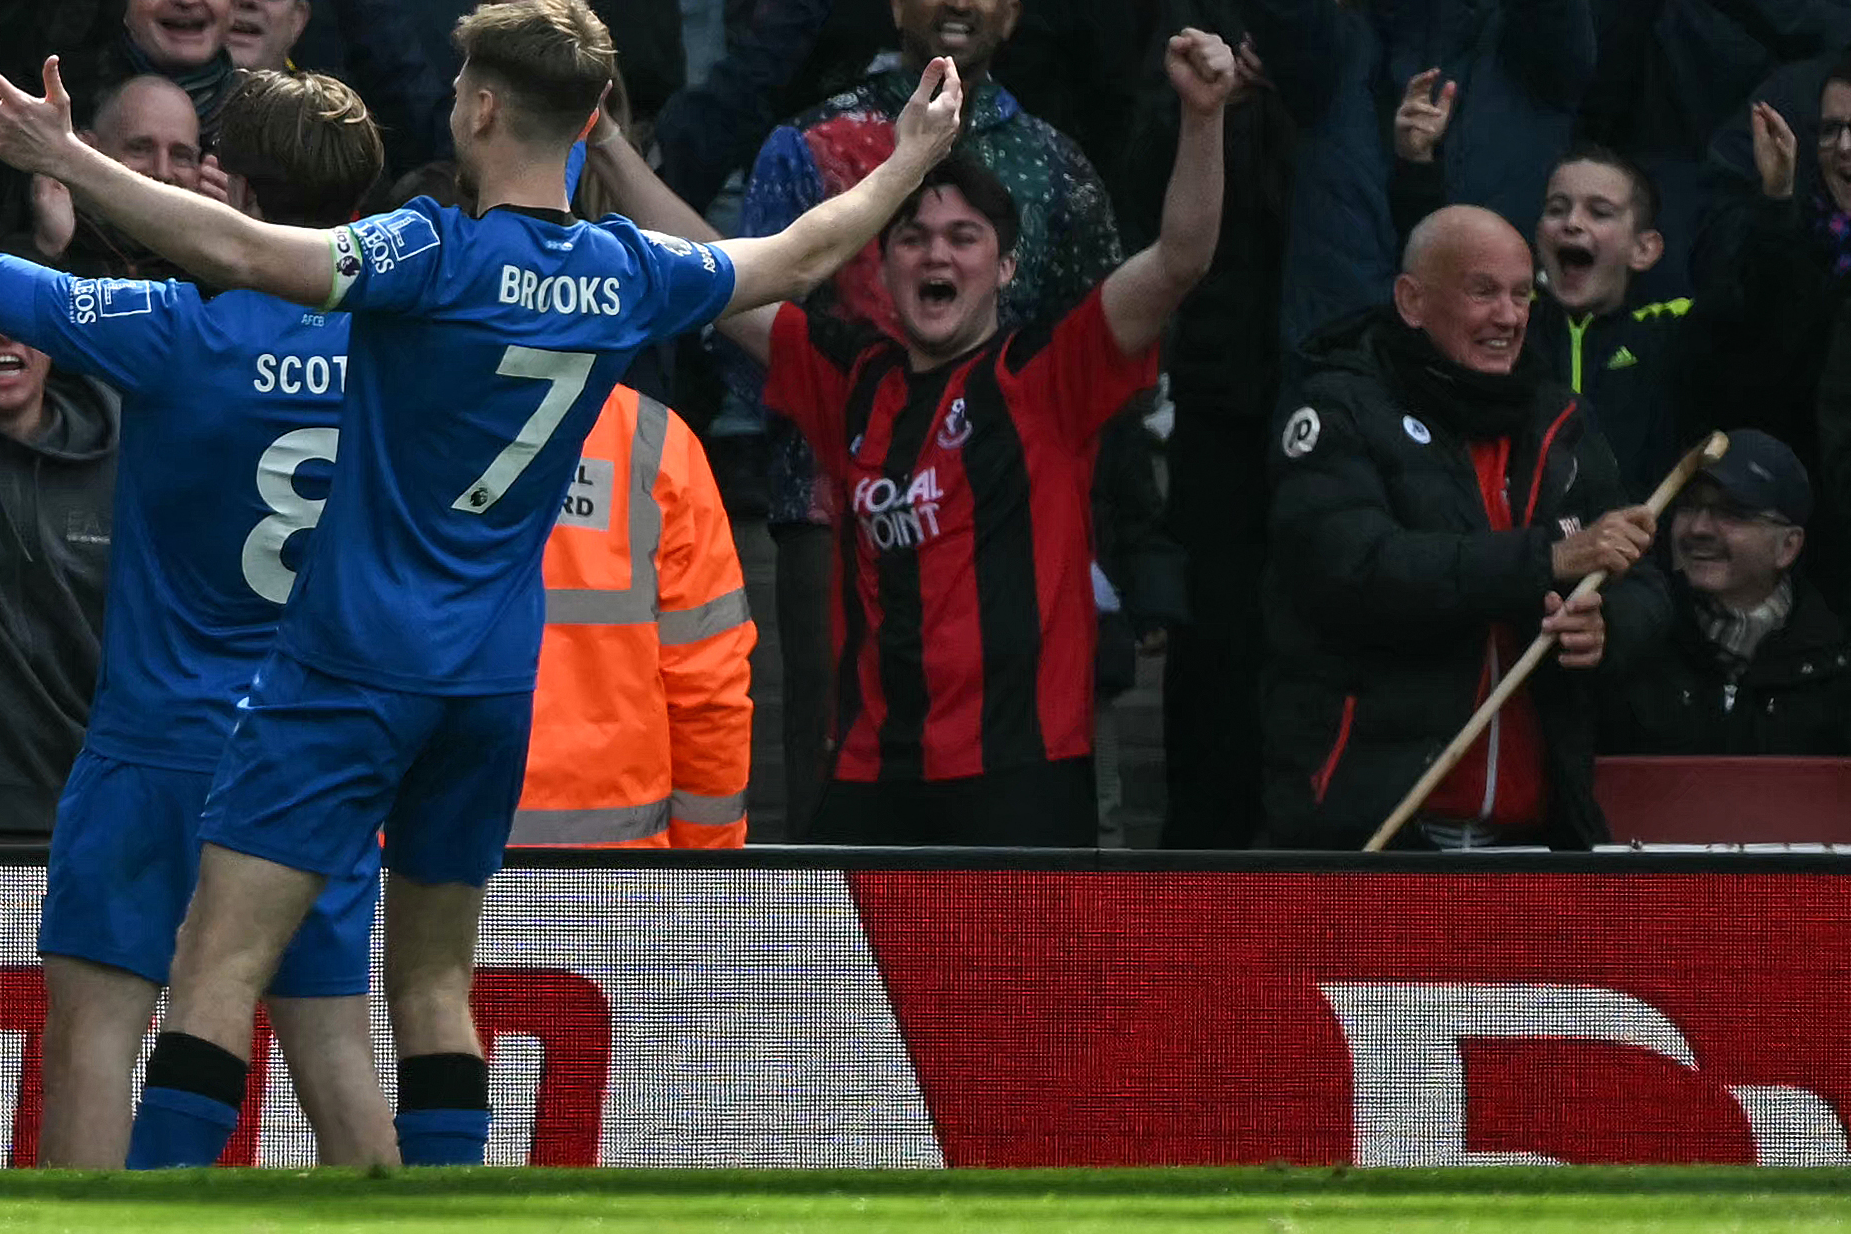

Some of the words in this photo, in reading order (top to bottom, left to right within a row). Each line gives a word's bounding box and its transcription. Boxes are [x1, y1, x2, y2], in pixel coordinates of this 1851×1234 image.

[498, 264, 621, 317] BROOKS
[452, 345, 597, 515] 7
[241, 426, 340, 605] 8
[852, 465, 945, 514] FOAL
